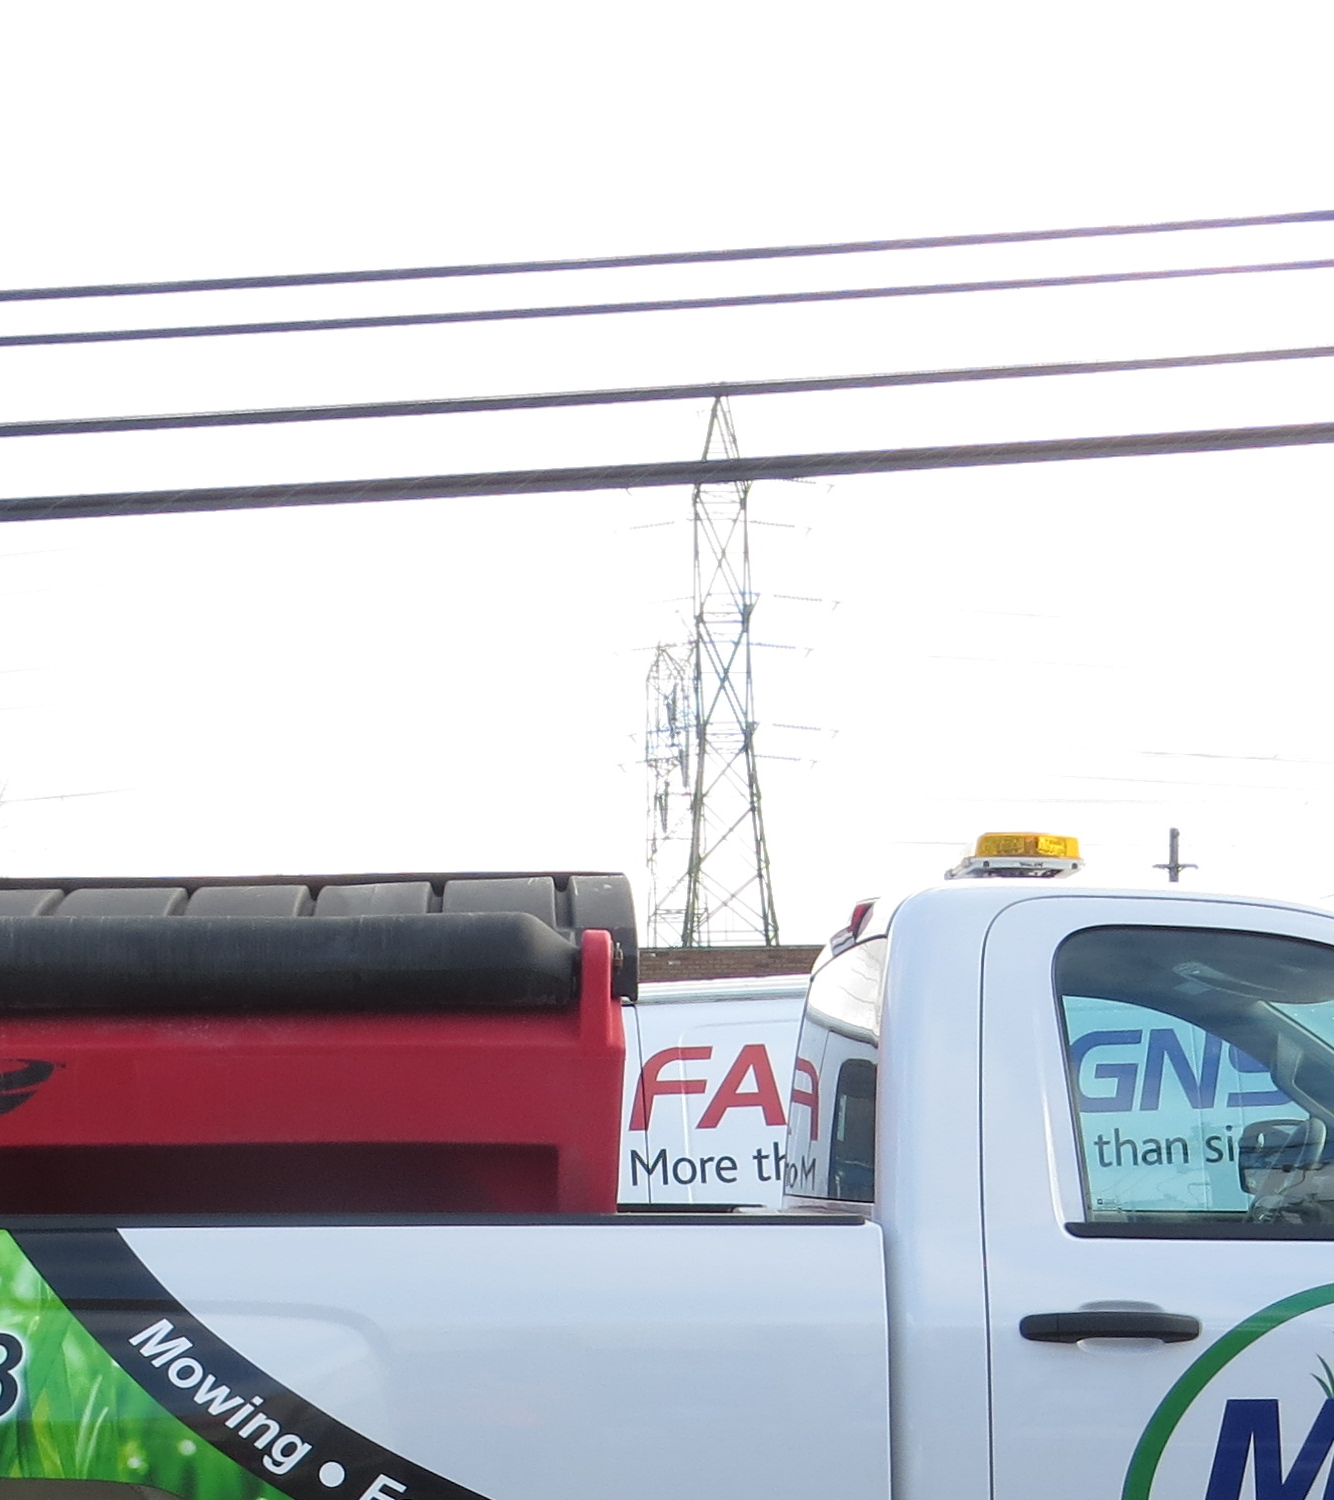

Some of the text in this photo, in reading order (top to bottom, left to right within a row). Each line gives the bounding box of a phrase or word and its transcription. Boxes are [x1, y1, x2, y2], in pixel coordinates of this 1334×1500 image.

[1094, 1126, 1234, 1167] than si
[630, 1149, 738, 1186] More
[129, 1318, 312, 1476] Mowing
